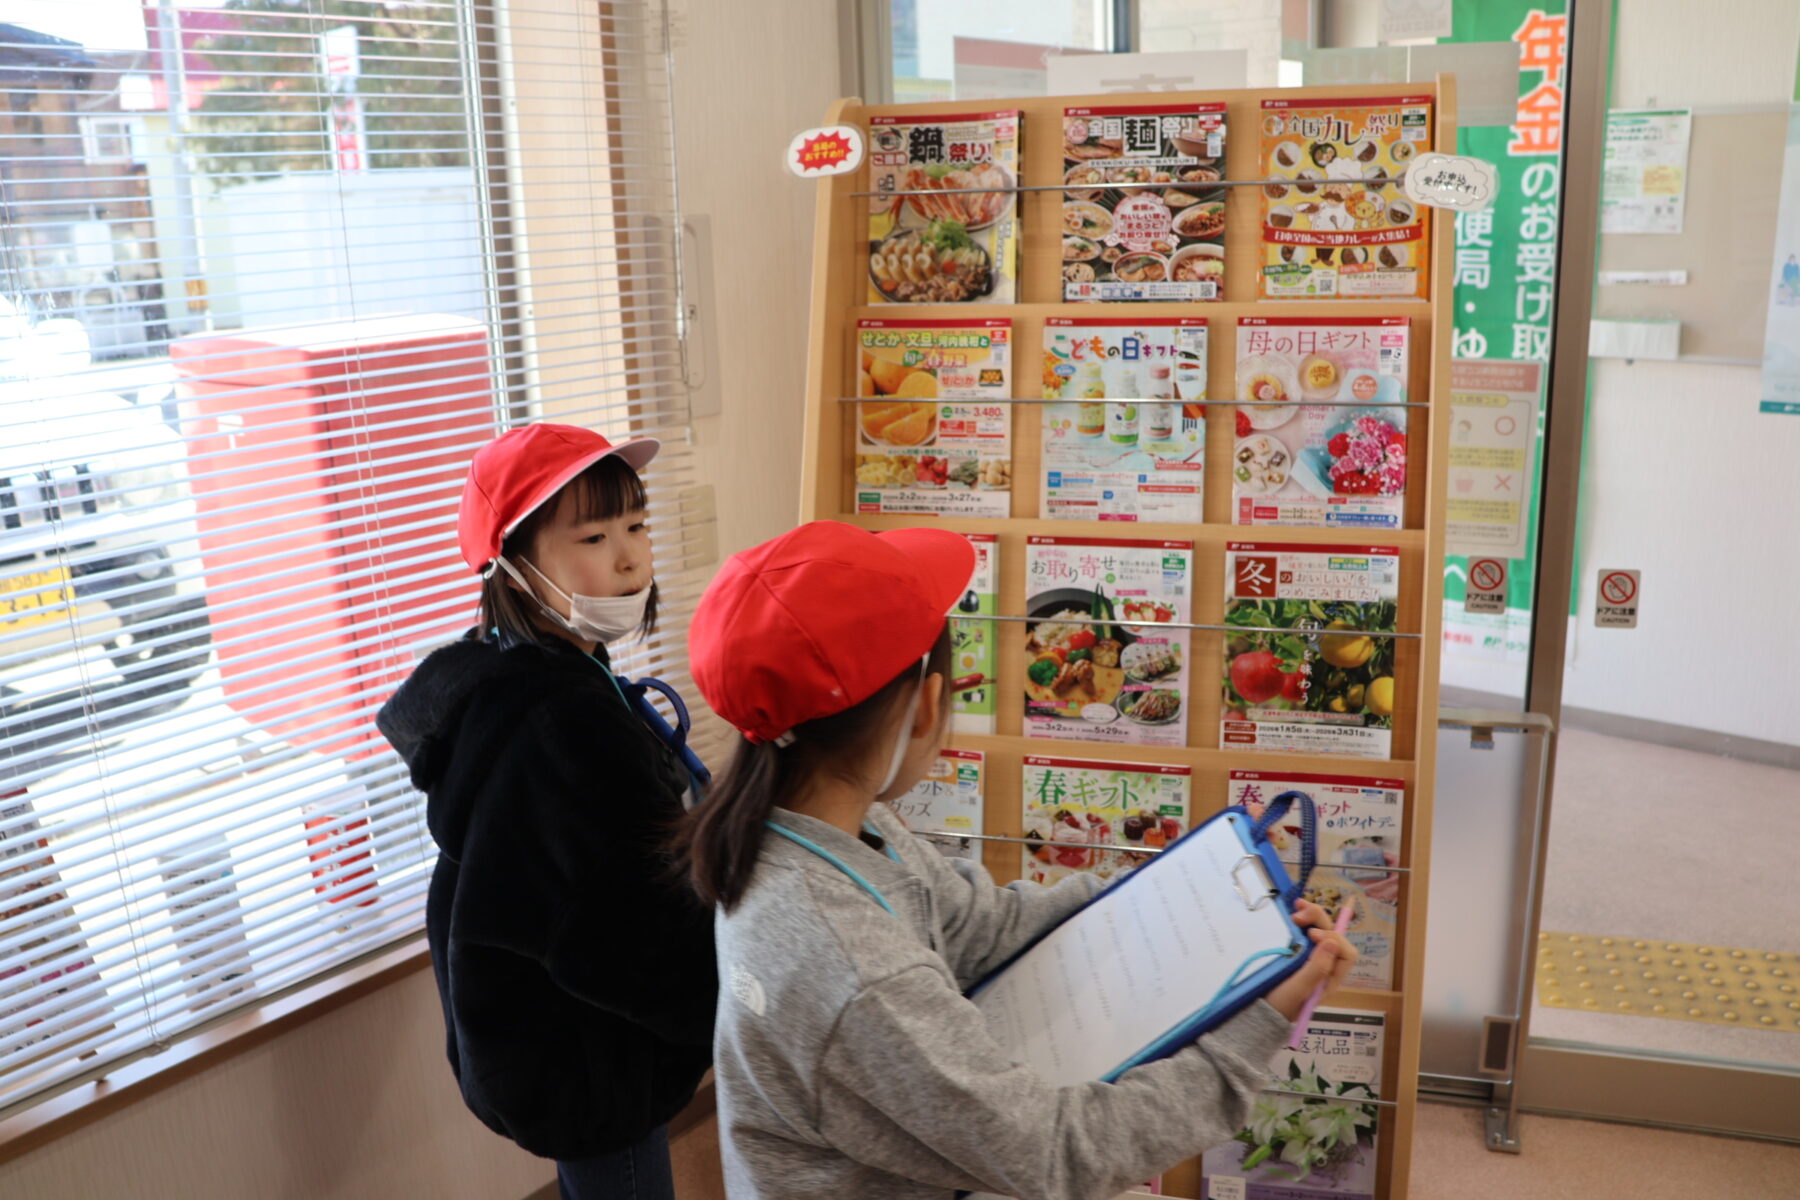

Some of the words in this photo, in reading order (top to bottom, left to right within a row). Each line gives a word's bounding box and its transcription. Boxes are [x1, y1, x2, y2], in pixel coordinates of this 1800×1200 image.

[1050, 334, 1179, 360] こどもの日ギフト
[1246, 330, 1372, 355] 母の日ギフト
[1032, 553, 1118, 583] お取り寄せ
[1239, 559, 1273, 595] 冬
[1466, 593, 1504, 602] ドアに注意
[1597, 607, 1636, 616] ドアに注意
[1034, 769, 1140, 811] 春ギフト
[1337, 815, 1396, 829] ホワイトデー
